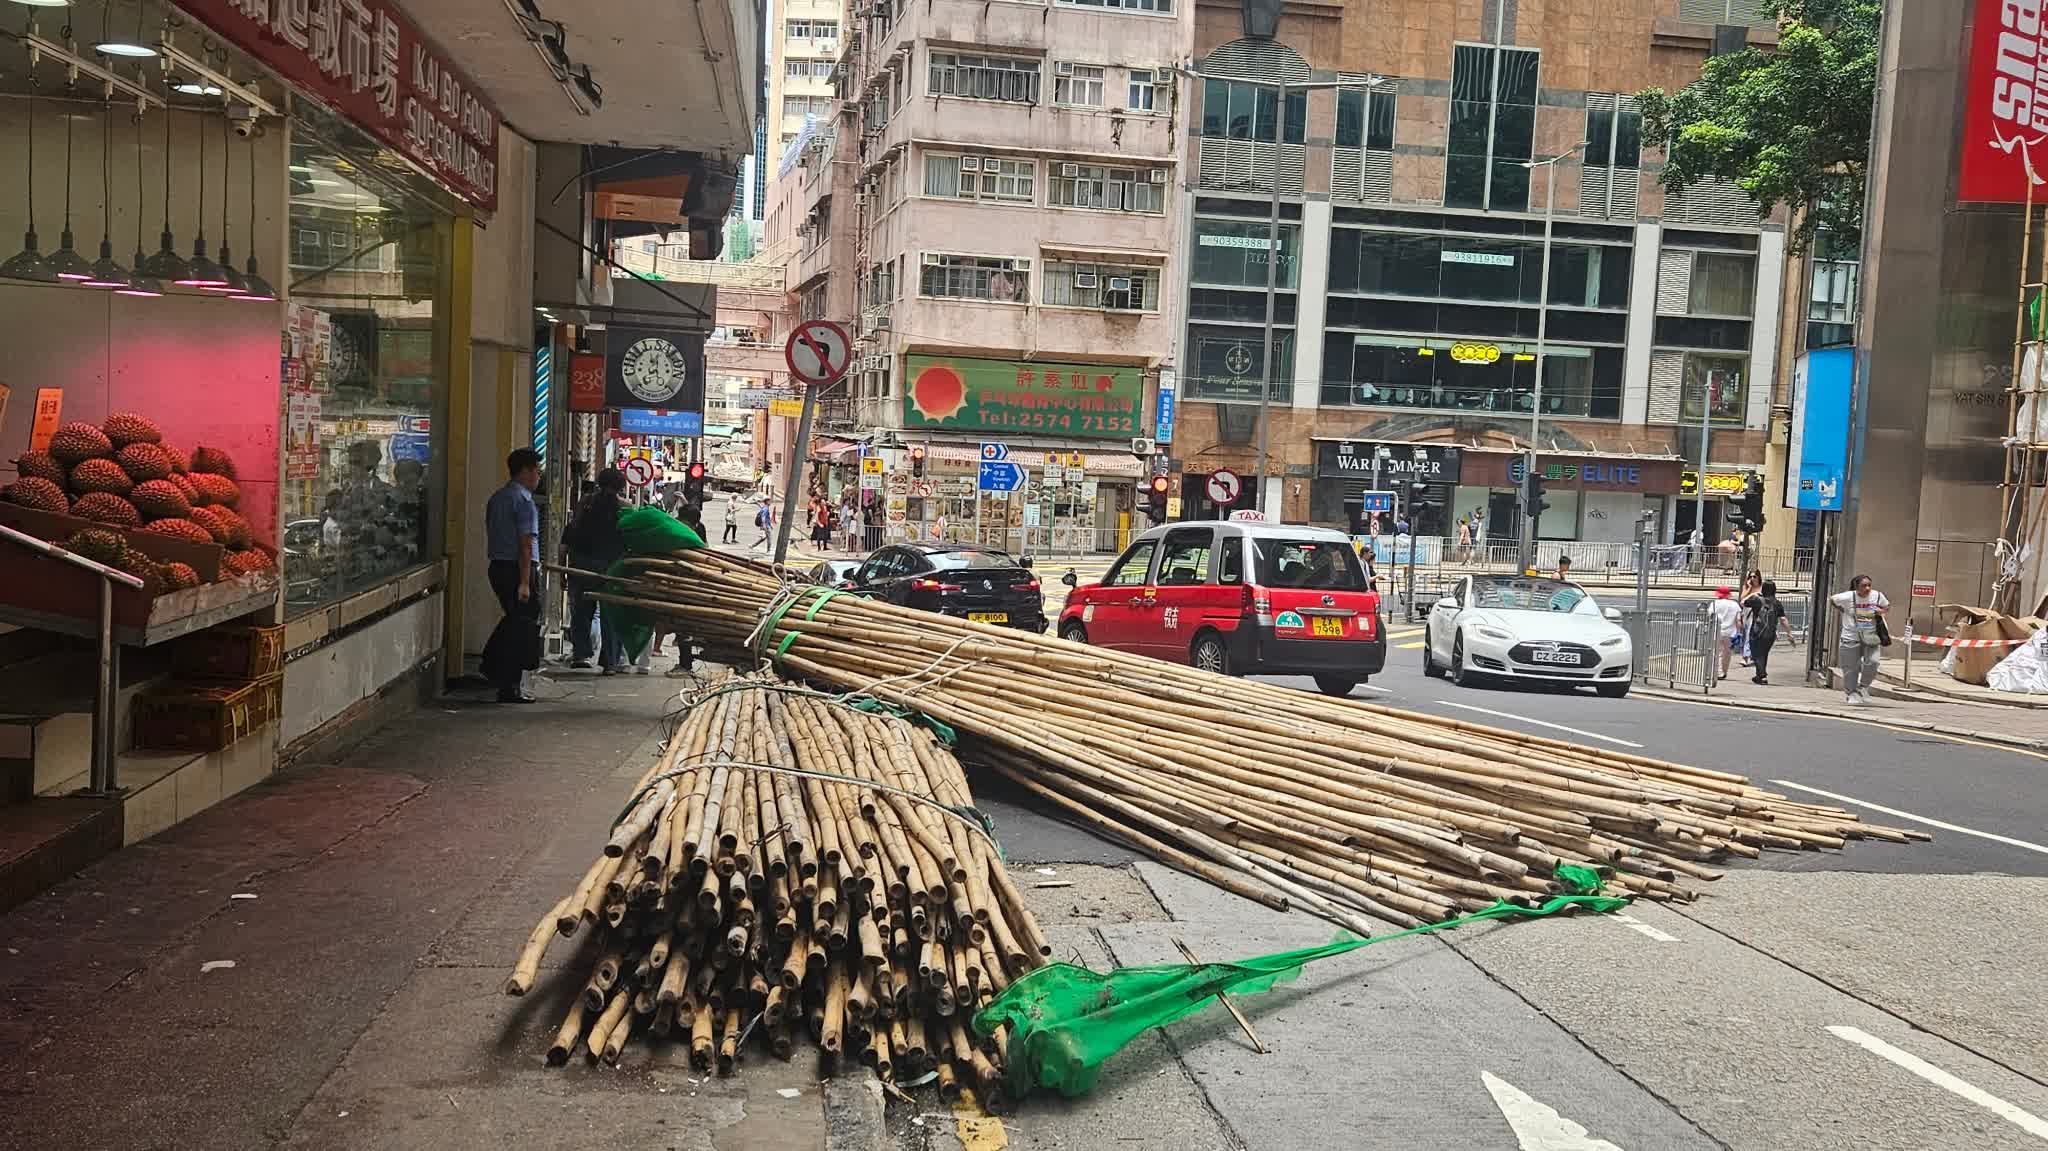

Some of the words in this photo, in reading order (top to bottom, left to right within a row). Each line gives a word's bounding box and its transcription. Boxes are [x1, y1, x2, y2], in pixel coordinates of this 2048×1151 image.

[412, 42, 440, 100] KAI
[440, 71, 461, 119] BO
[463, 91, 492, 146] FOOD
[404, 96, 496, 196] SUPERMARKET
[623, 340, 653, 376] CHILL
[654, 340, 685, 380] SALON
[1082, 415, 1133, 432] 7152
[1583, 463, 1641, 483] ELITE
[1238, 511, 1264, 521] TAXI
[1164, 606, 1179, 617] 的士
[1164, 617, 1178, 629] TAXI
[1316, 626, 1341, 635] 7998
[1536, 651, 1550, 661] CZ
[1552, 653, 1578, 663] 2225
